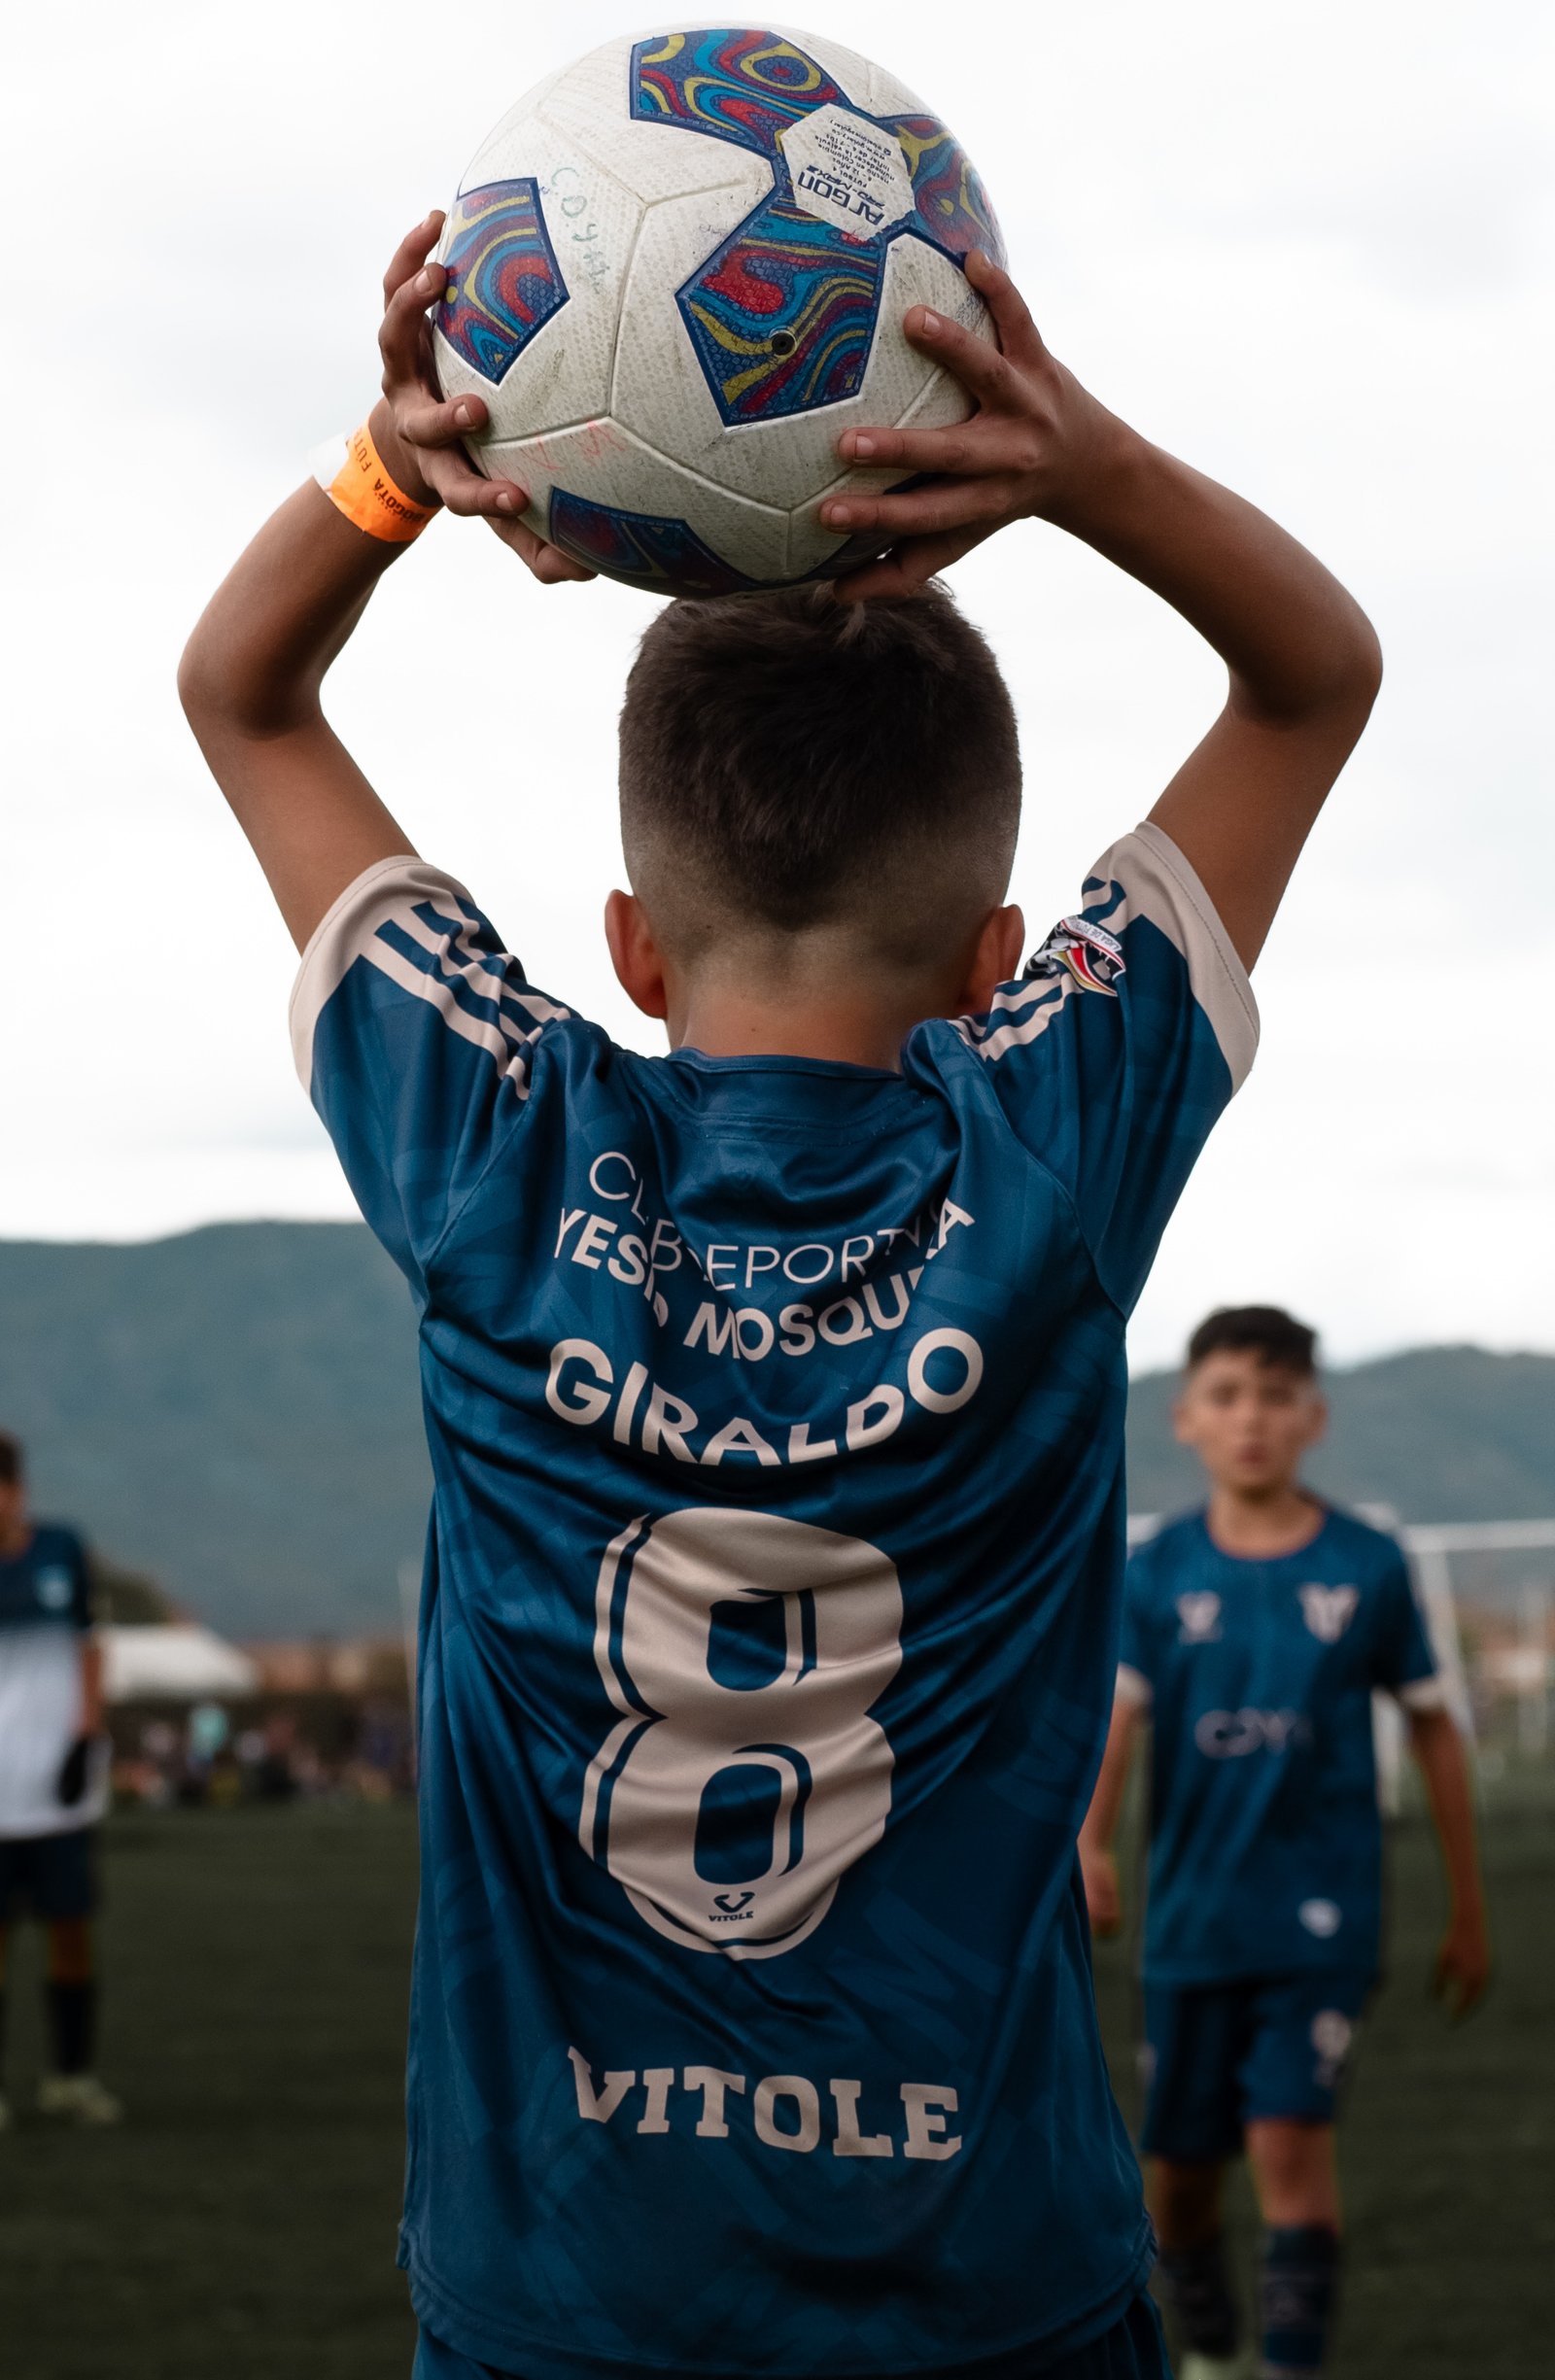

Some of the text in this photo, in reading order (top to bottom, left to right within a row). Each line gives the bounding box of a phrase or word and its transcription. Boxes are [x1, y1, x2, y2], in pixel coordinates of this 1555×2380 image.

[589, 1151, 682, 1271] CLB
[683, 1197, 976, 1362] MOSQUA
[545, 1328, 984, 1466] GIRALDO
[578, 1507, 904, 1960] 8
[708, 1911, 753, 1922] VITOLE
[568, 2046, 961, 2160] VITOLE
